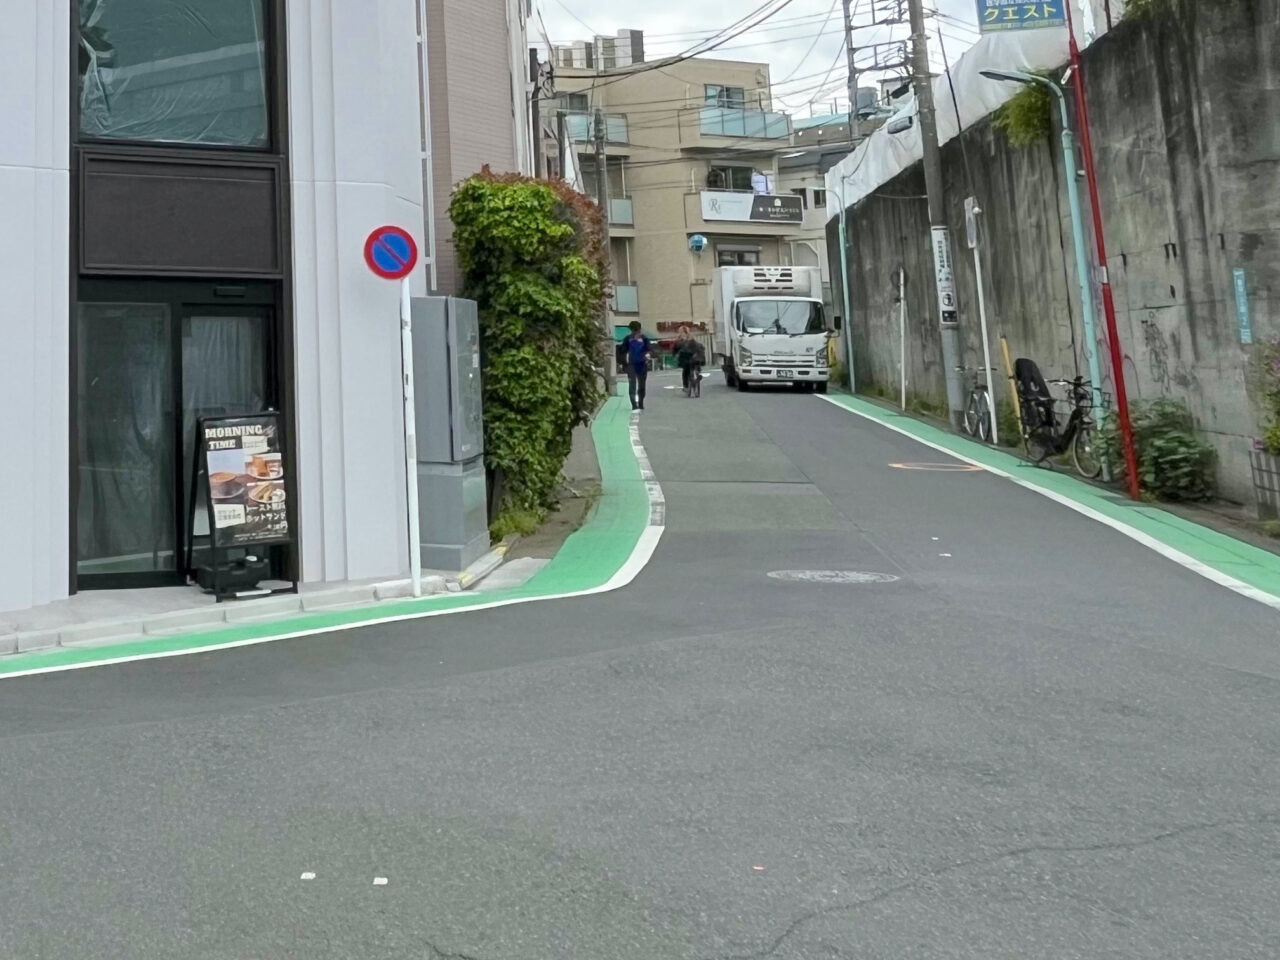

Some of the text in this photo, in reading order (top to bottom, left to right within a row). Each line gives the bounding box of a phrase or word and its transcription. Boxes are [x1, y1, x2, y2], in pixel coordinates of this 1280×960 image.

[983, 3, 1057, 22] クエスト
[205, 425, 263, 438] MORNING
[209, 439, 236, 449] TIME
